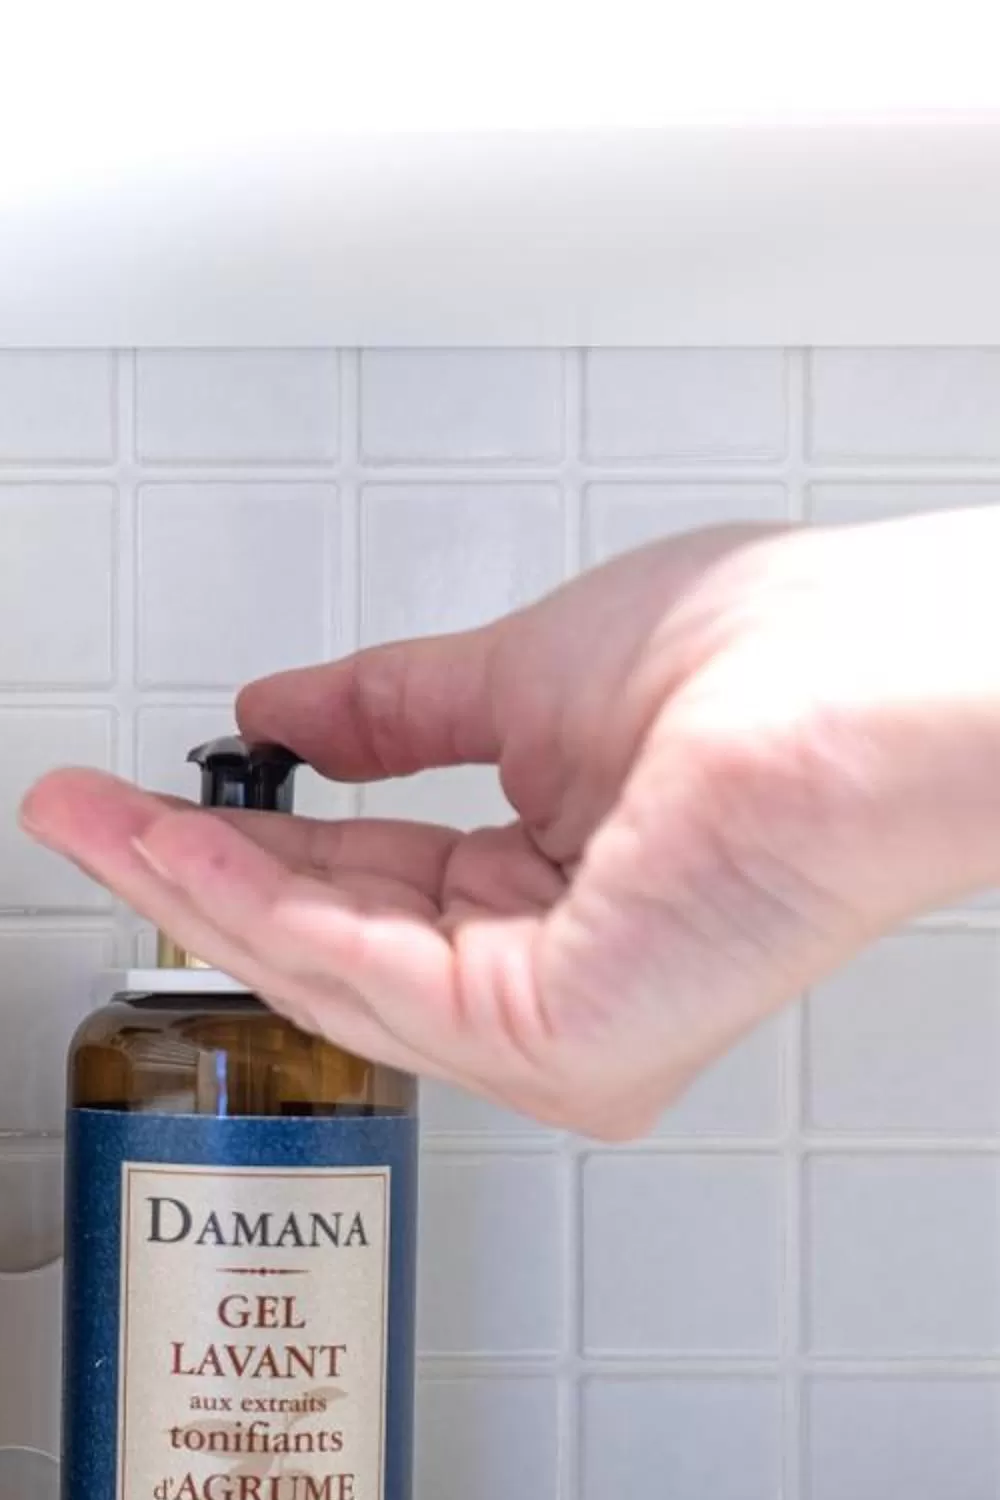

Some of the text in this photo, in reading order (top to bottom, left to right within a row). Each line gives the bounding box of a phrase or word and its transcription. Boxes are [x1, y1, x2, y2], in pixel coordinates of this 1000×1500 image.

[145, 1196, 370, 1248] DAMANA
[217, 1294, 306, 1329] GEL
[170, 1342, 347, 1379] LAVANT
[189, 1392, 327, 1413] aux extraits
[169, 1421, 343, 1453] tonifiants
